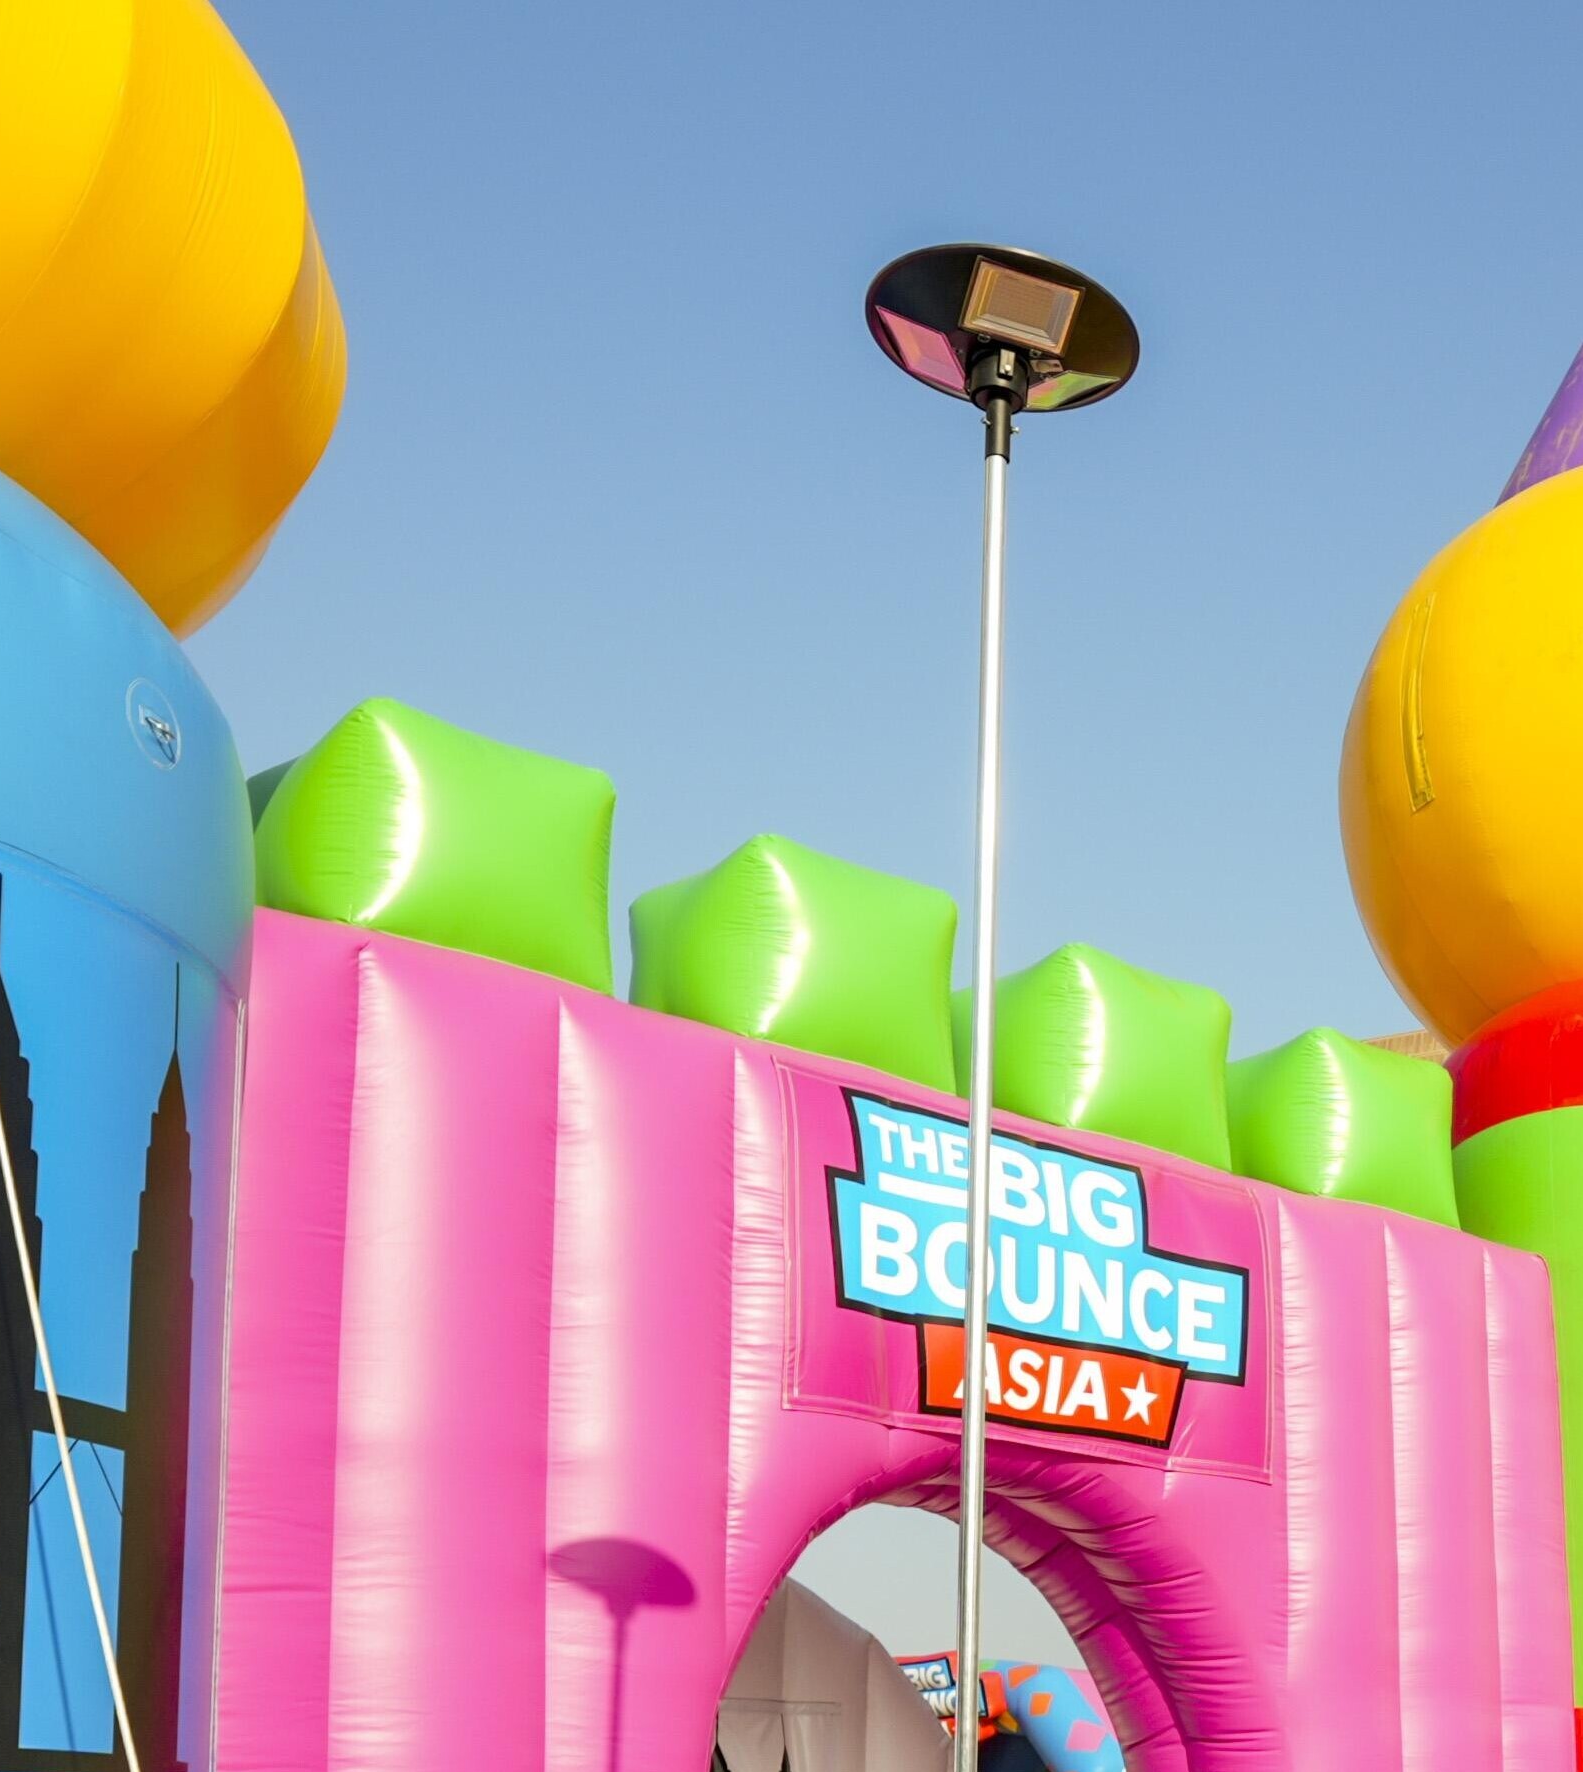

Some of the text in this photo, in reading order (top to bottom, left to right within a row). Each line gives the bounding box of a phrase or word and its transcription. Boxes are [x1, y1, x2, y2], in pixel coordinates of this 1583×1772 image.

[868, 1113, 1135, 1248] THE BIG
[859, 1201, 1227, 1362] BOUNCE
